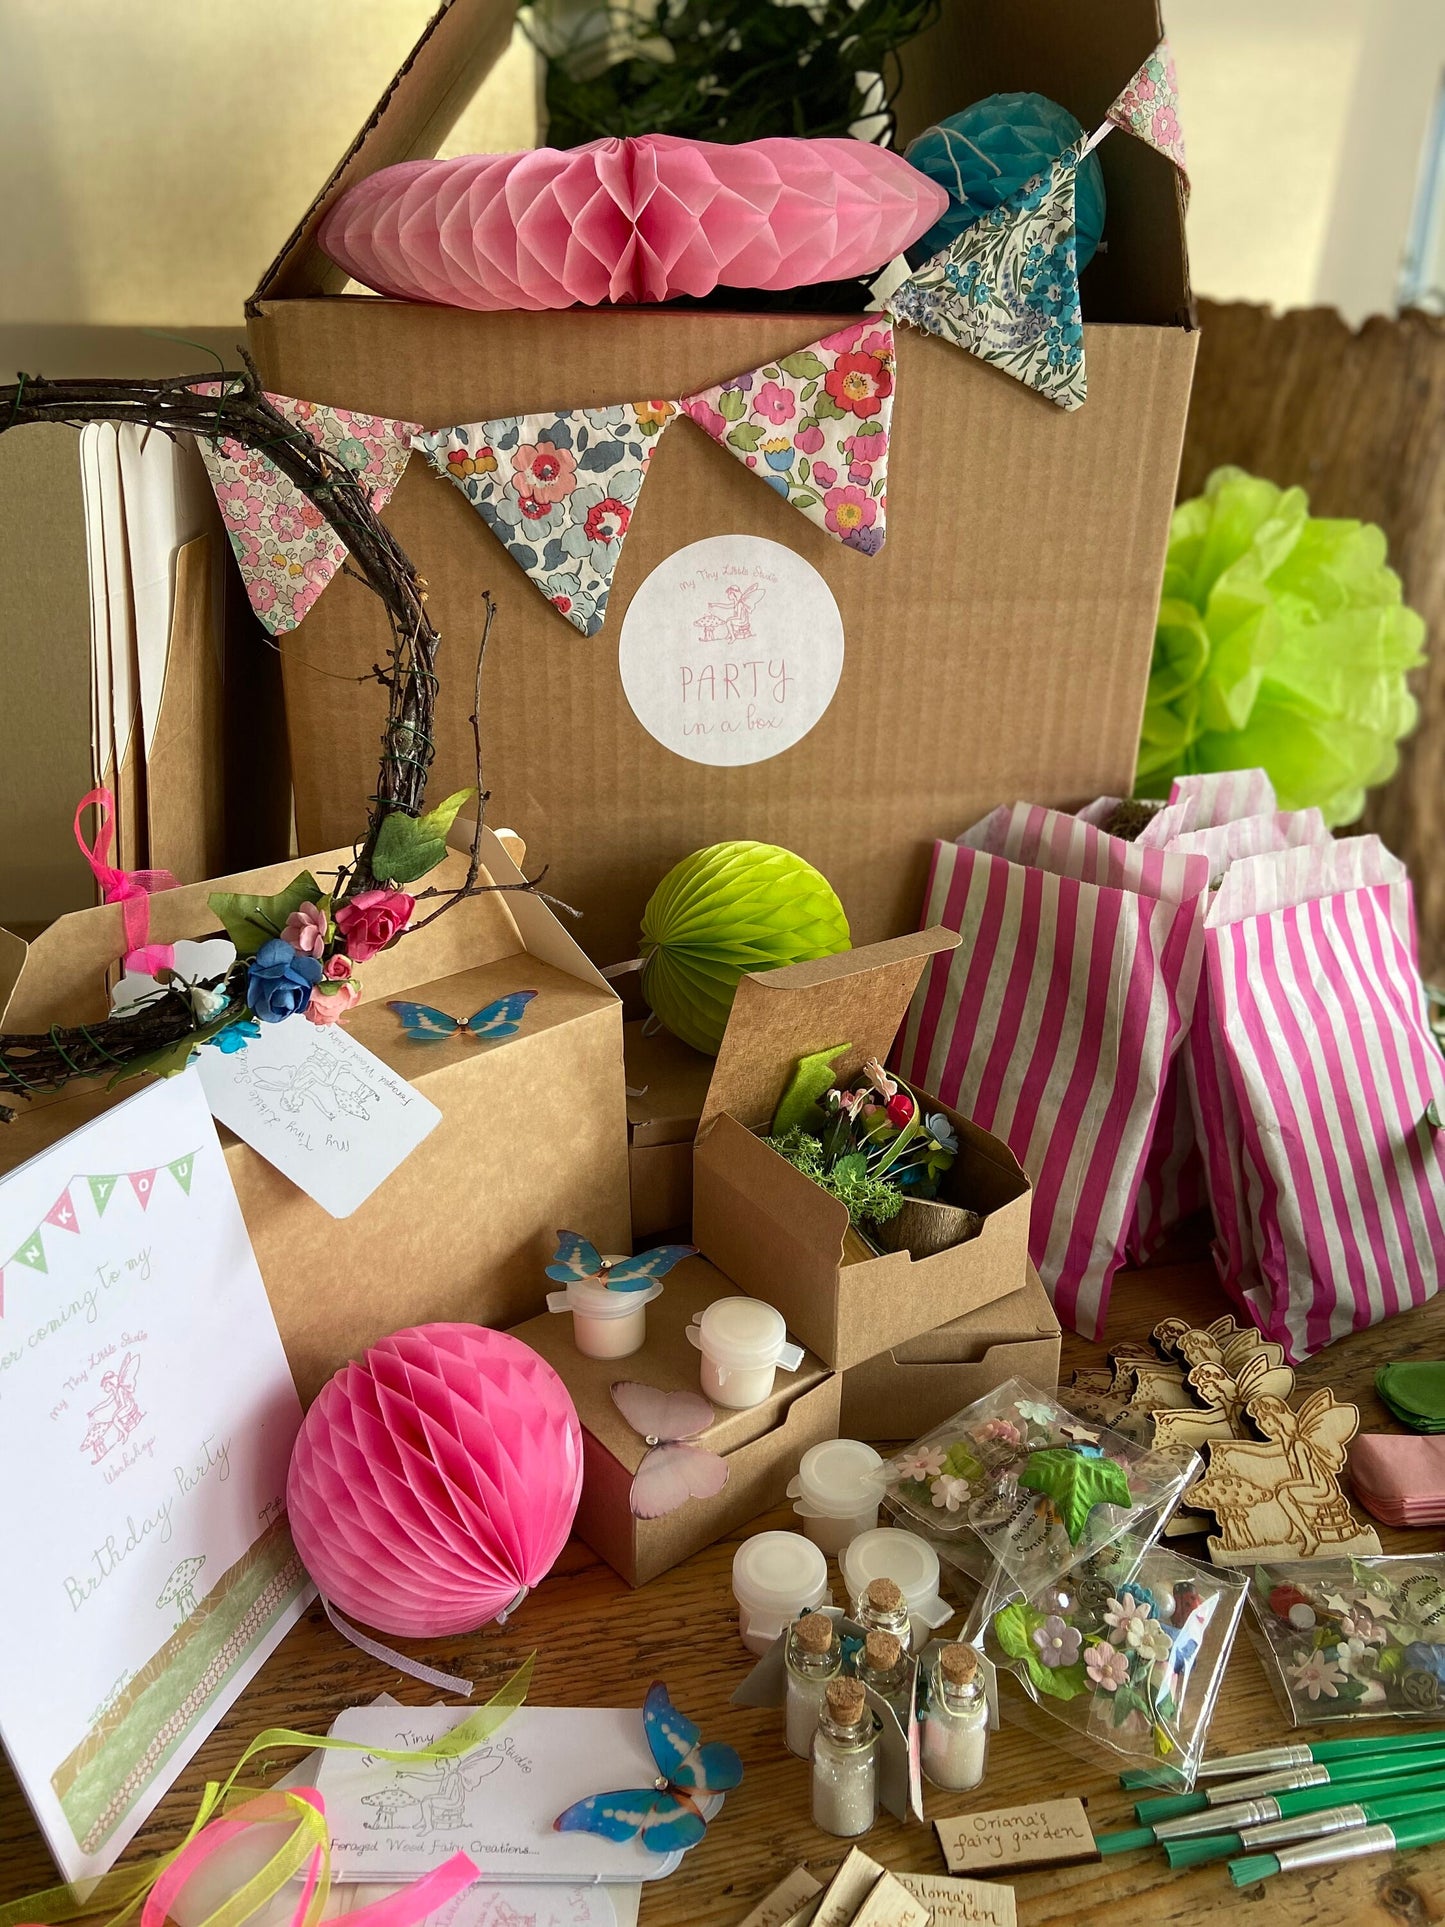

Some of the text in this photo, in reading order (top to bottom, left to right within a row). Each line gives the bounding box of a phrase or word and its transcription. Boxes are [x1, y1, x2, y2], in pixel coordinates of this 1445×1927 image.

[697, 569, 719, 582] Tiny
[679, 658, 794, 704] PARTY
[683, 703, 784, 736] in a box
[286, 1121, 314, 1152] Tiny
[97, 1161, 190, 1199] YOU
[28, 1287, 99, 1349] coming
[95, 1261, 120, 1289] to
[125, 1246, 151, 1281] my
[63, 1370, 88, 1392] Tiny
[103, 1435, 156, 1486] Workshop
[62, 1434, 231, 1613] Birthday Party
[984, 1490, 1034, 1536] Compostable
[1016, 1526, 1052, 1553] Certified
[395, 1730, 435, 1746] Tiny
[496, 1737, 532, 1774] Studio
[973, 1812, 1047, 1831] Oriana's
[386, 1838, 424, 1851] Wood
[953, 1826, 1084, 1861] fairy garden
[926, 1905, 1002, 1927] garden
